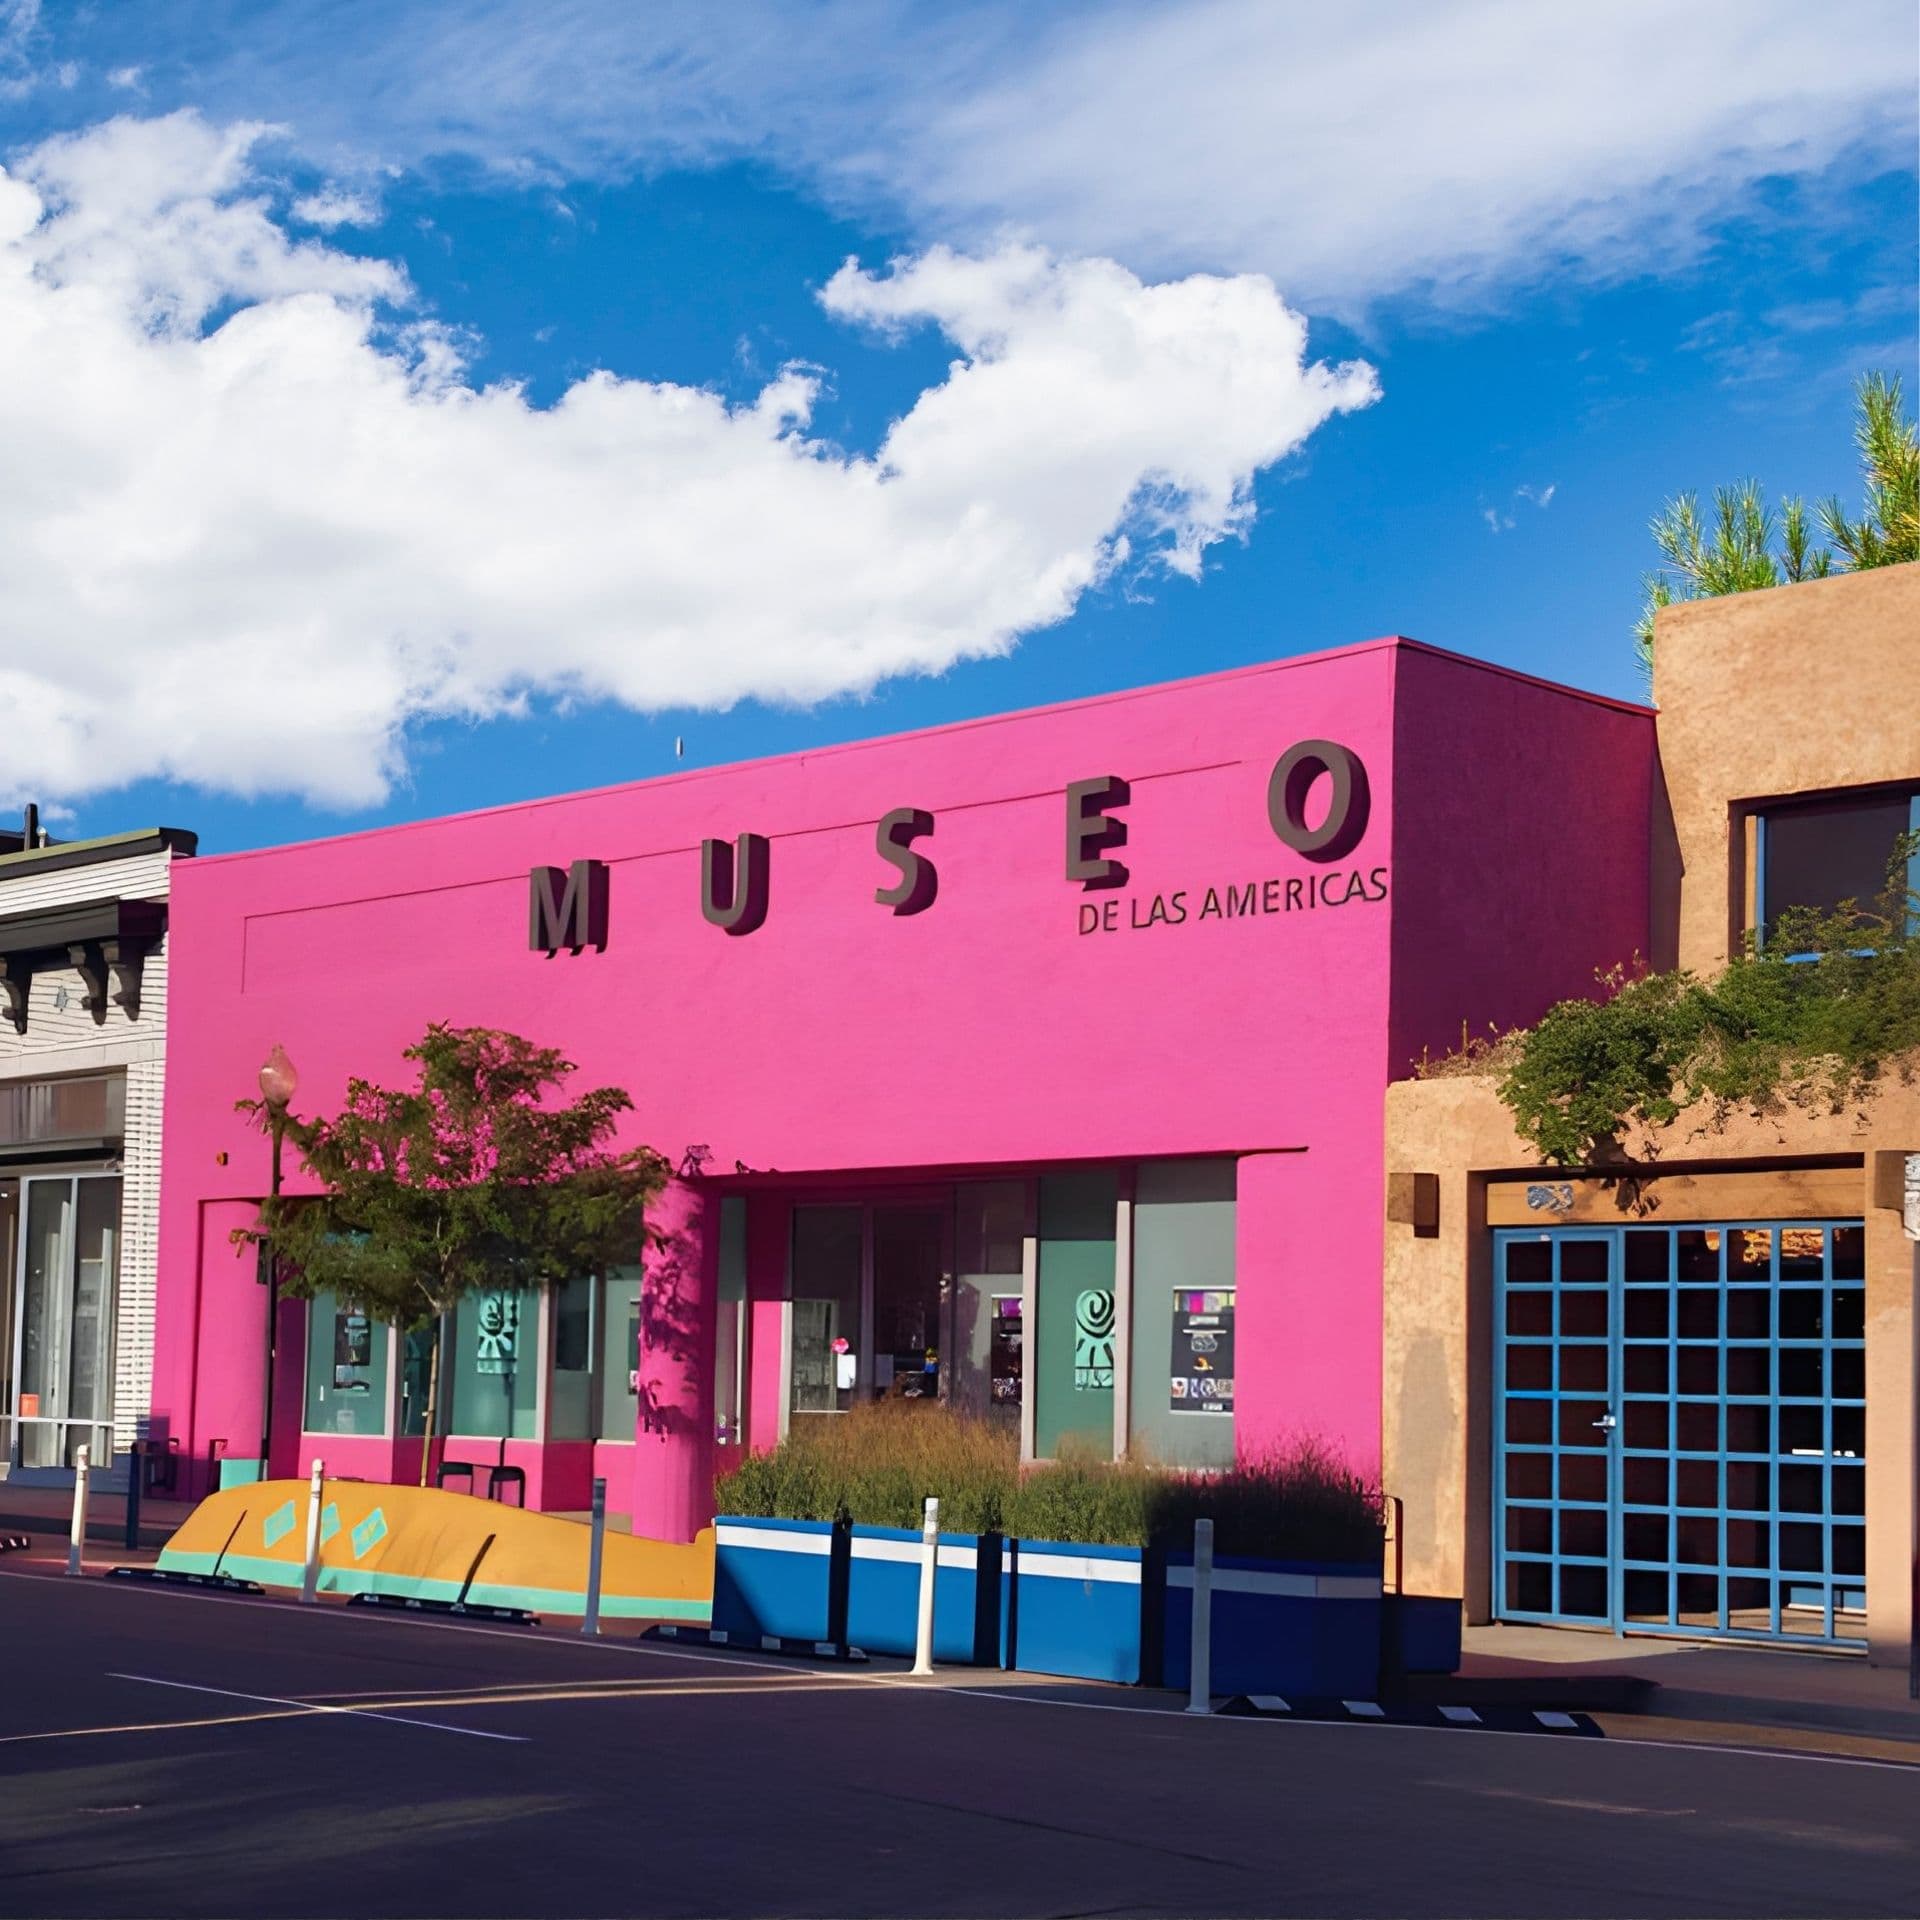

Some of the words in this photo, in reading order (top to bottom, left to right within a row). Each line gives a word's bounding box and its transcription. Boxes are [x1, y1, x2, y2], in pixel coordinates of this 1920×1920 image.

[529, 739, 1370, 957] MUSEO
[1079, 900, 1119, 935] DE
[1131, 891, 1187, 929] LAS
[1199, 867, 1388, 921] AMERICAS
